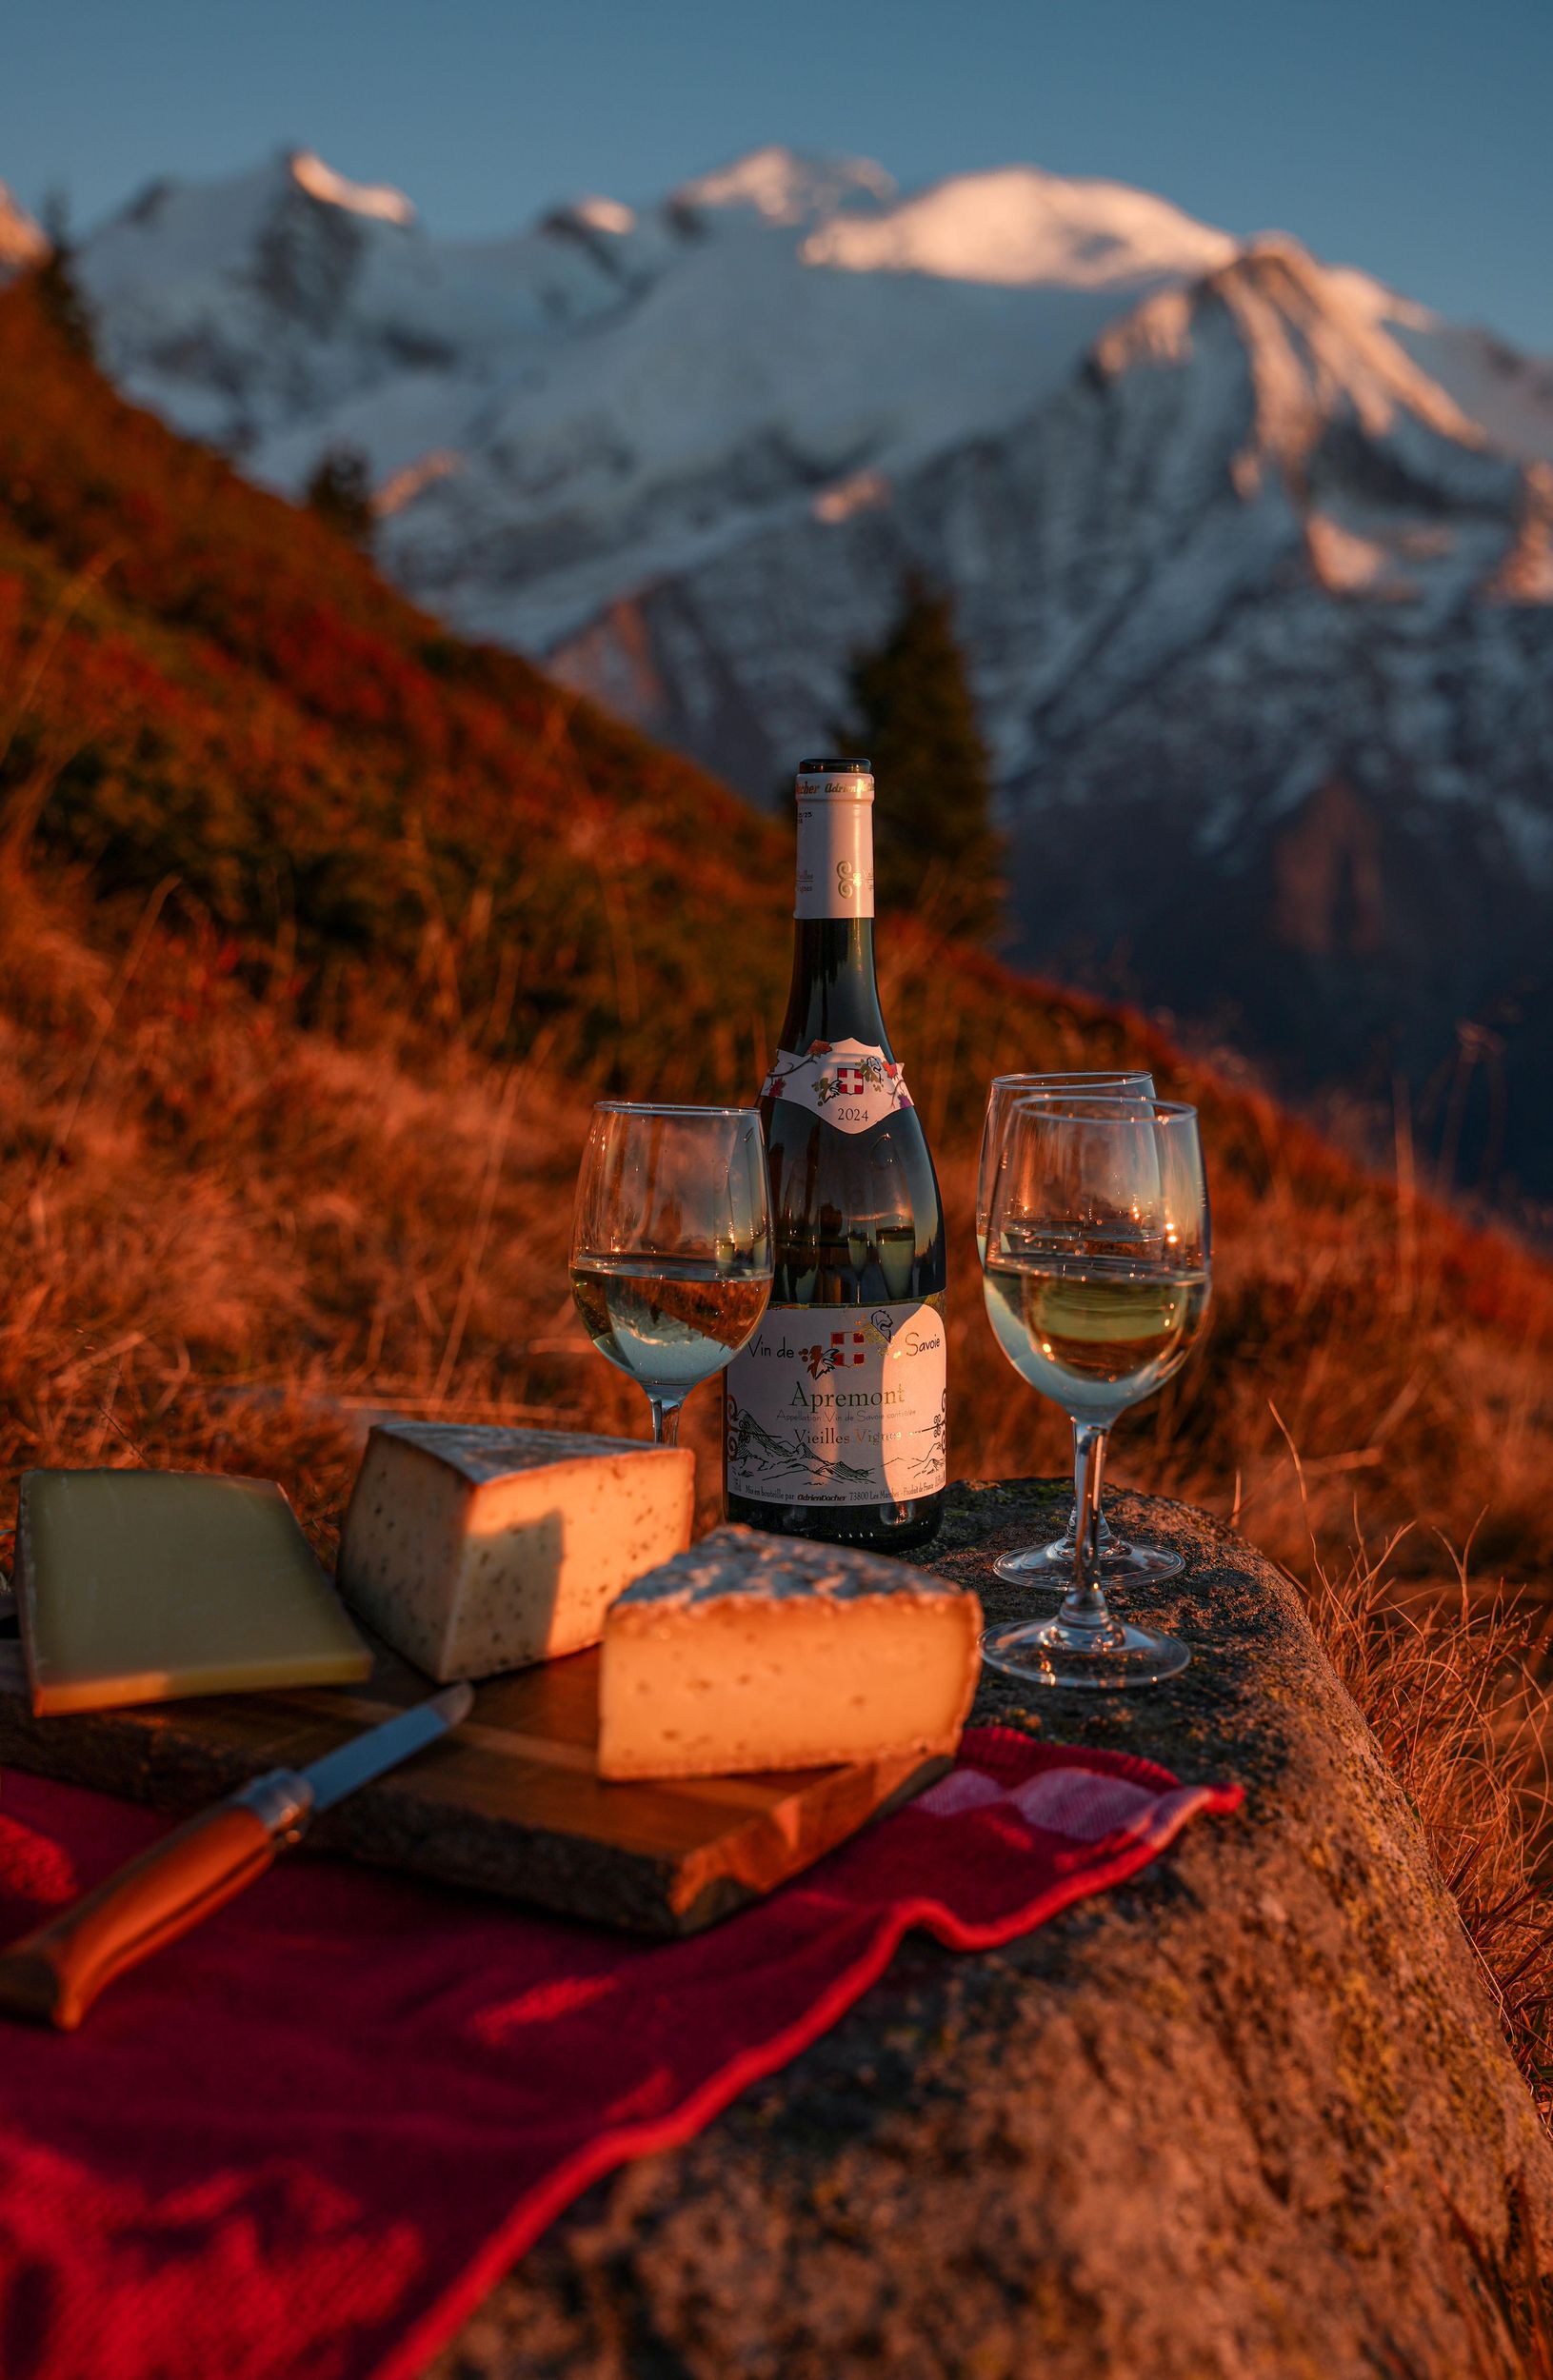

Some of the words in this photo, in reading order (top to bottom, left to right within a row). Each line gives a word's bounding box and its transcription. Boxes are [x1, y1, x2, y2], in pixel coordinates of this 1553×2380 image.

[837, 1107, 869, 1121] 2024
[747, 1334, 771, 1358] Vin
[776, 1336, 795, 1359] de
[905, 1332, 941, 1357] Savoie
[788, 1381, 906, 1413] Apremont
[776, 1409, 822, 1423] Appellation
[824, 1410, 843, 1423] Vin
[845, 1412, 855, 1422] de
[856, 1409, 885, 1423] Savoie
[794, 1428, 851, 1444] Vieilles
[785, 1493, 795, 1501] par
